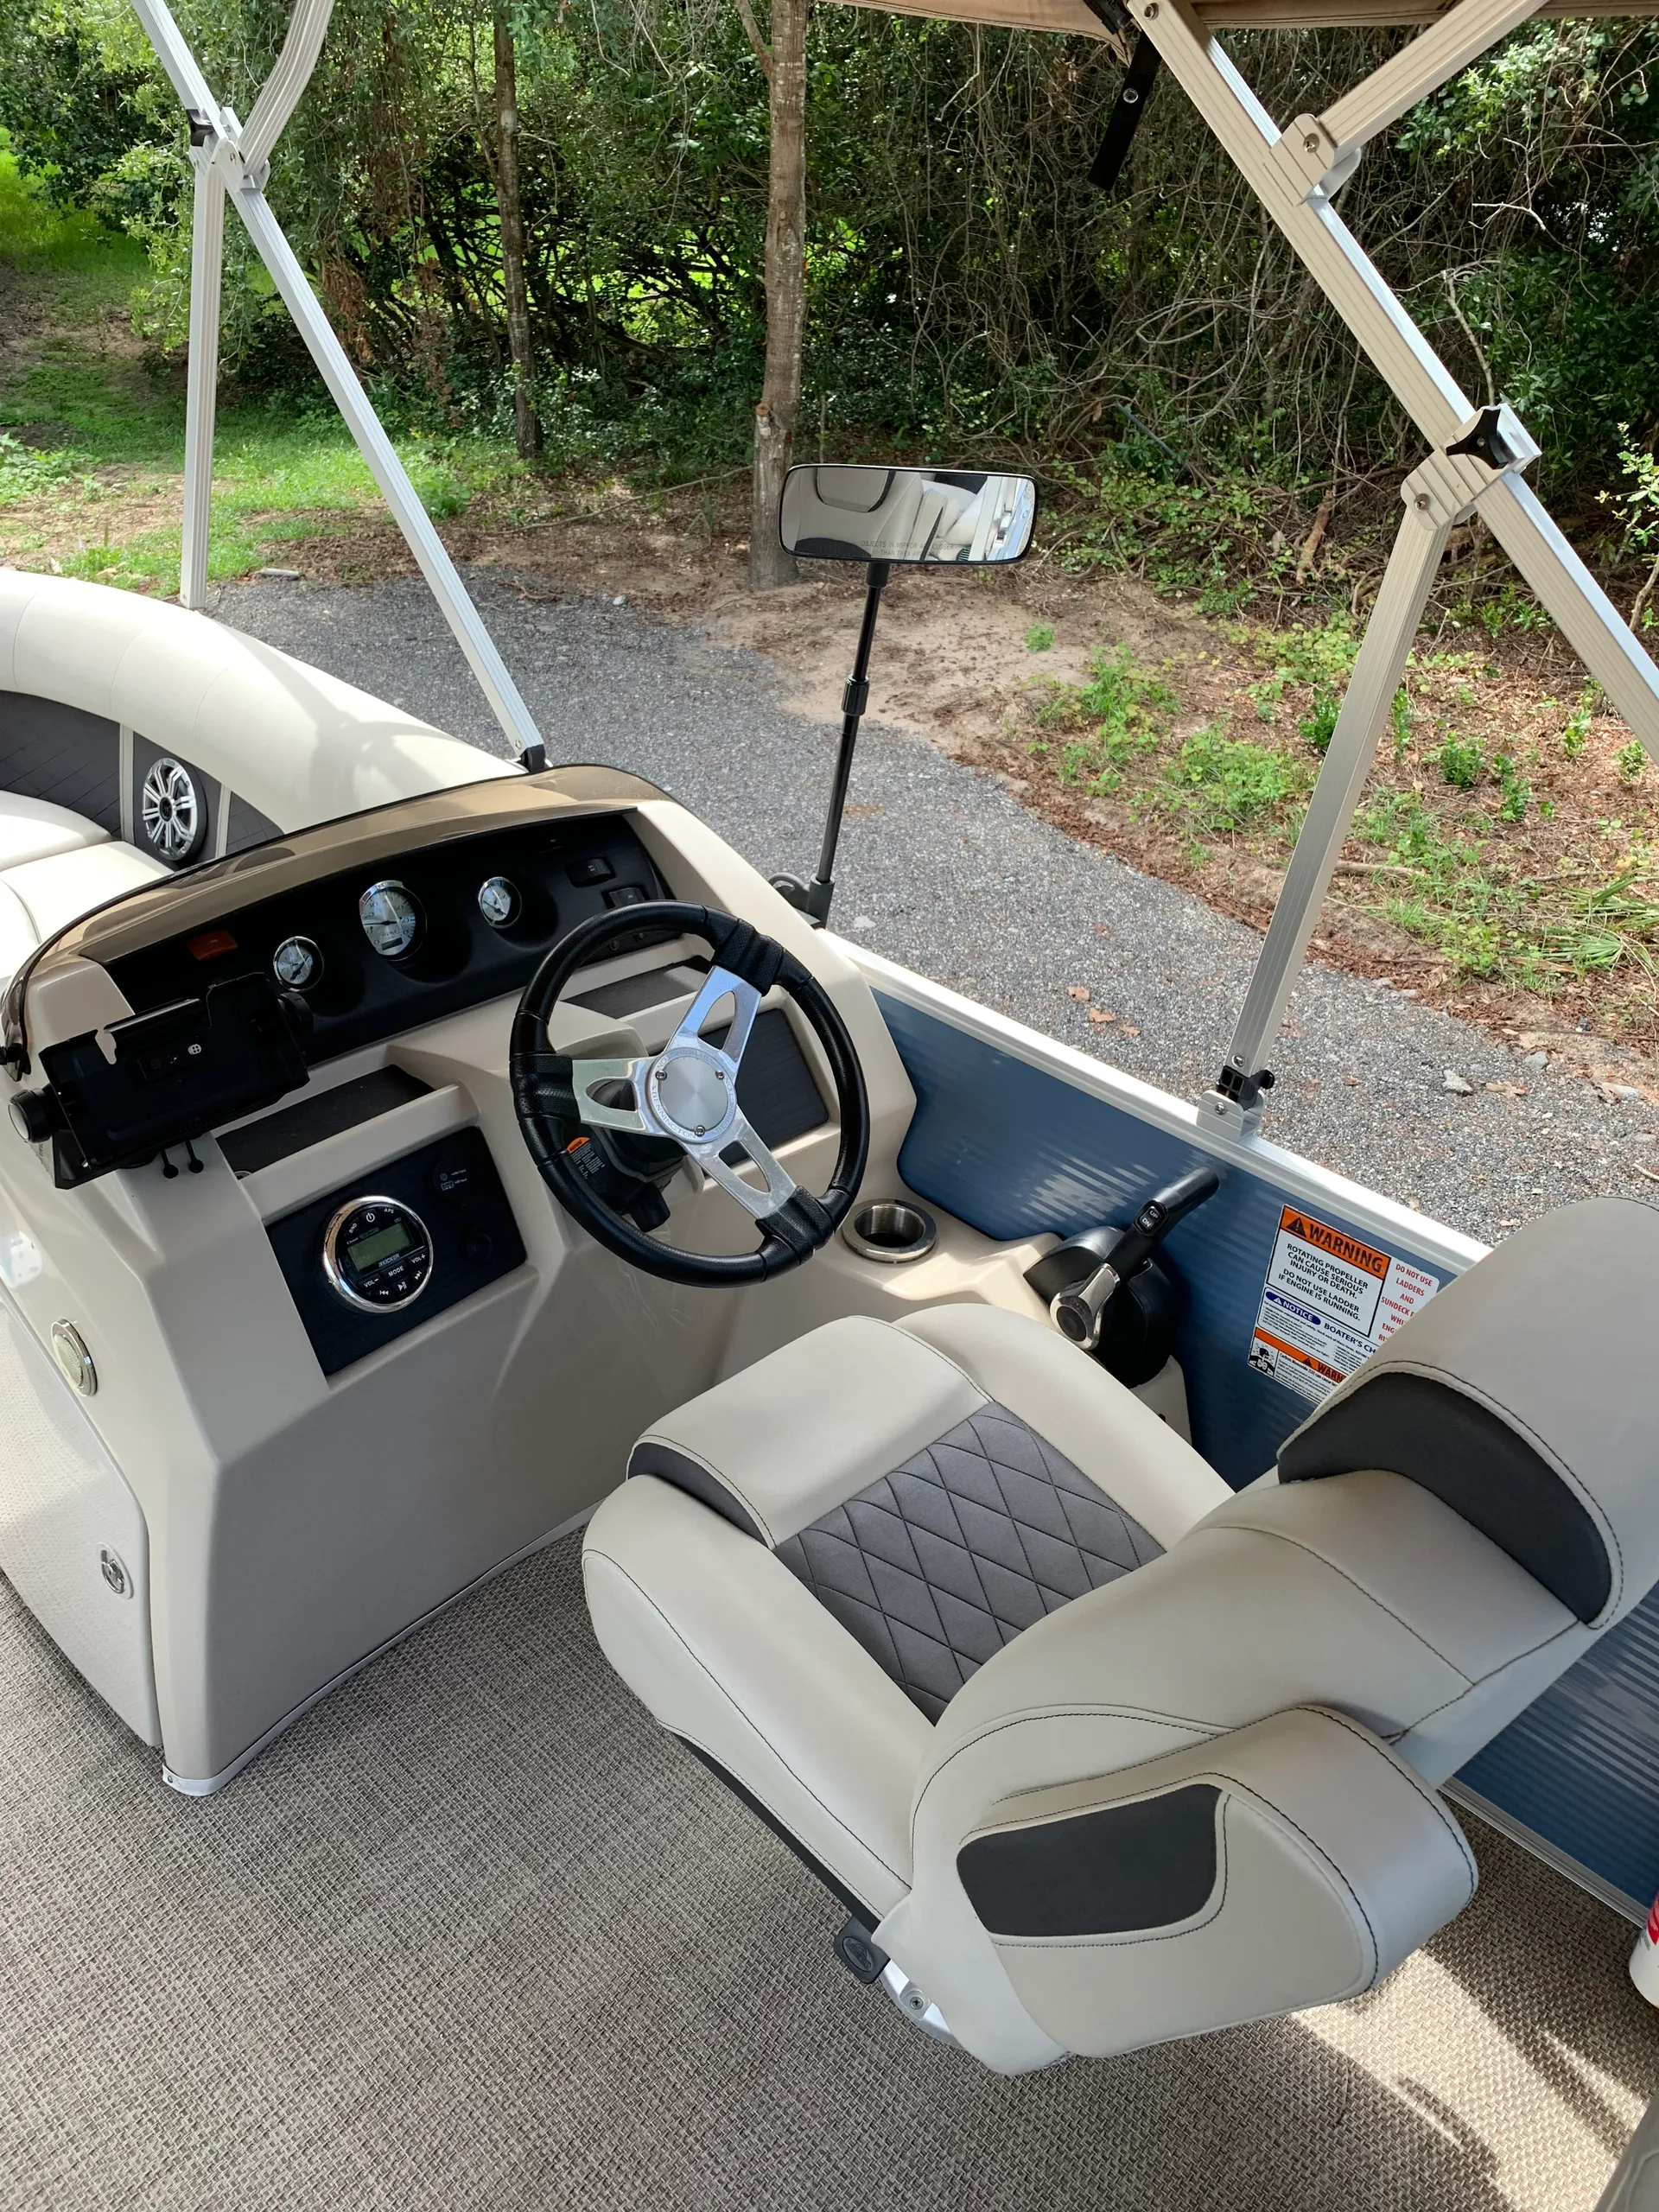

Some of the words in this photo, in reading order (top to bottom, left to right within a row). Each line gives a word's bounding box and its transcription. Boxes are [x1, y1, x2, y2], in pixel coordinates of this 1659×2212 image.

[651, 1091, 696, 1139] BENNINGTON
[1141, 1217, 1152, 1228] DN
[1149, 1210, 1159, 1218] UP
[1309, 1223, 1383, 1274] WARNING
[387, 1265, 404, 1277] MODE
[1287, 1243, 1324, 1267] ROTATING
[1325, 1262, 1369, 1289] PROPELLER
[1287, 1251, 1304, 1264] CAN
[1305, 1260, 1330, 1277] CAUSE
[1331, 1273, 1363, 1294] SERIOUS
[1395, 1263, 1405, 1273] DO
[1406, 1268, 1420, 1280] NOT
[1420, 1275, 1433, 1287] USE
[1283, 1268, 1294, 1279] DO
[1296, 1274, 1313, 1287] NOT
[1313, 1283, 1328, 1296] USE
[1329, 1292, 1360, 1313] LADDER
[1290, 1260, 1317, 1279] INJURY
[1318, 1274, 1329, 1284] OR
[1330, 1281, 1357, 1300] DEATH.
[1395, 1277, 1425, 1297] LADDERS
[1286, 1277, 1314, 1297] ENGINE
[1323, 1298, 1361, 1321] RUNNING.
[1380, 1296, 1410, 1316] SUNDECK
[1399, 1293, 1414, 1305] AND
[1282, 1300, 1313, 1322] NOTICE
[1390, 1313, 1407, 1325] WHI
[1324, 1323, 1363, 1348] BOATER'S
[1382, 1323, 1397, 1334] ENG
[1318, 1362, 1345, 1383] WARN
